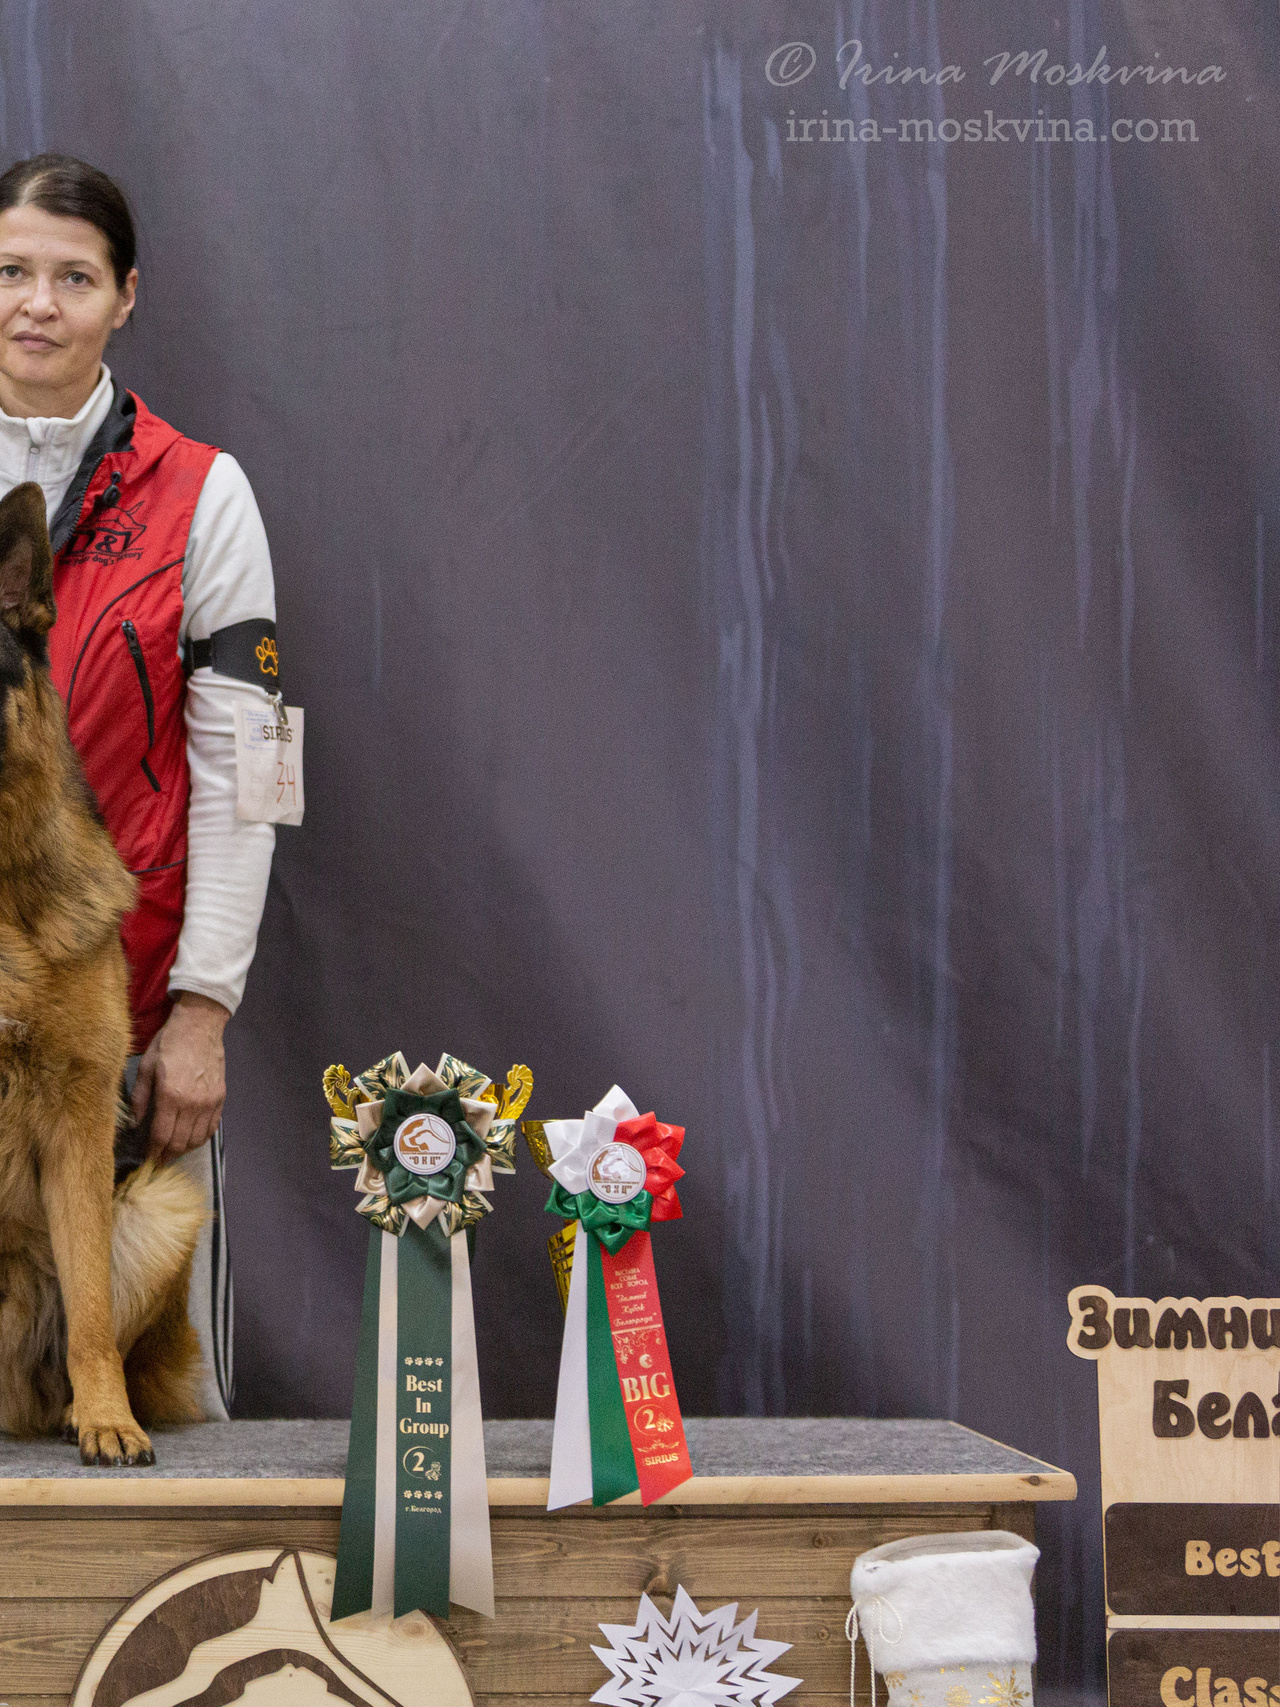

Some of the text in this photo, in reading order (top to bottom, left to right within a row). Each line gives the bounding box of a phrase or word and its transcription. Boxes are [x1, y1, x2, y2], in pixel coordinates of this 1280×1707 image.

[405, 1374, 443, 1393] Best
[622, 1372, 671, 1403] BIG
[415, 1397, 432, 1414] In
[399, 1417, 450, 1439] Group
[642, 1408, 656, 1430] 2
[412, 1451, 425, 1472] 2
[644, 1452, 679, 1466] SIRIUS
